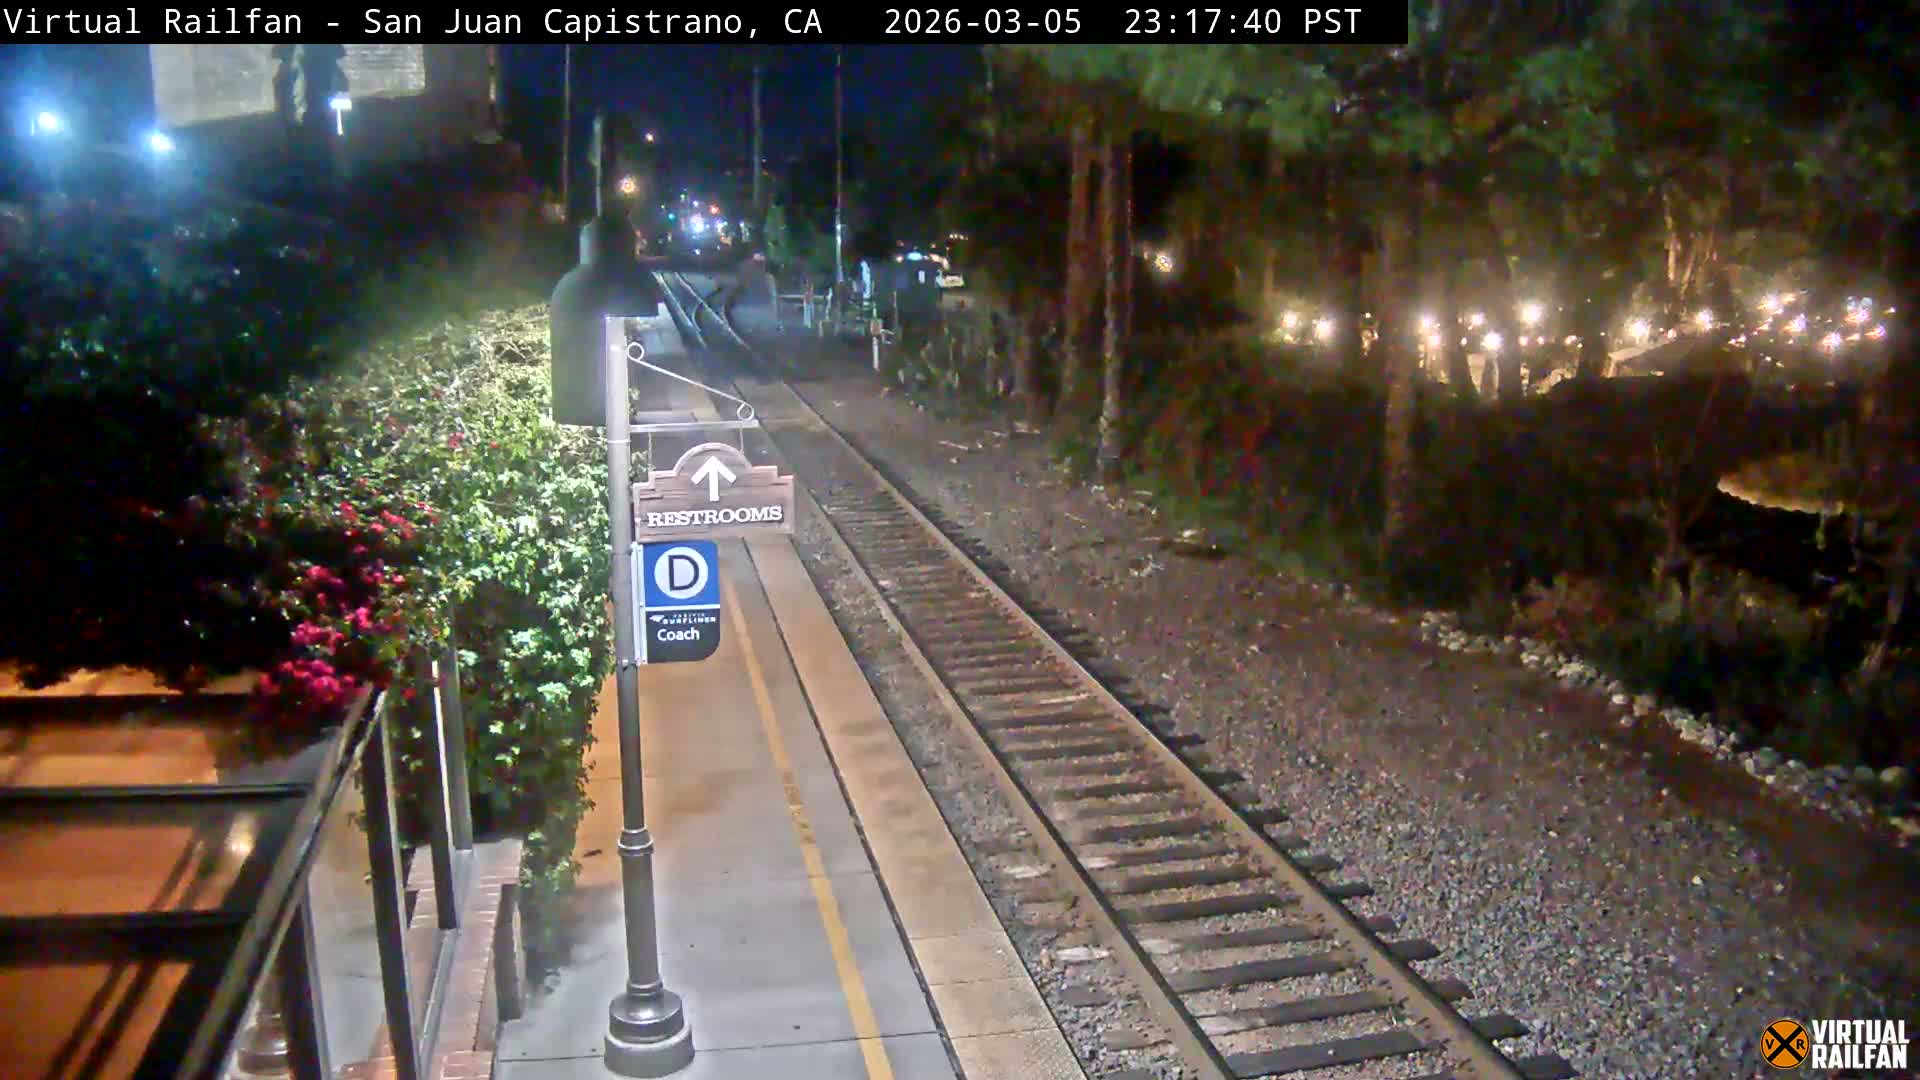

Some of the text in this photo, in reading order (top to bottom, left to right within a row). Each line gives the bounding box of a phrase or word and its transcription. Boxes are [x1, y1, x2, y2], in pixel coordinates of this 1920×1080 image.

[647, 506, 783, 527] RESTROOMS
[668, 554, 700, 591] D
[657, 627, 700, 641] Coach
